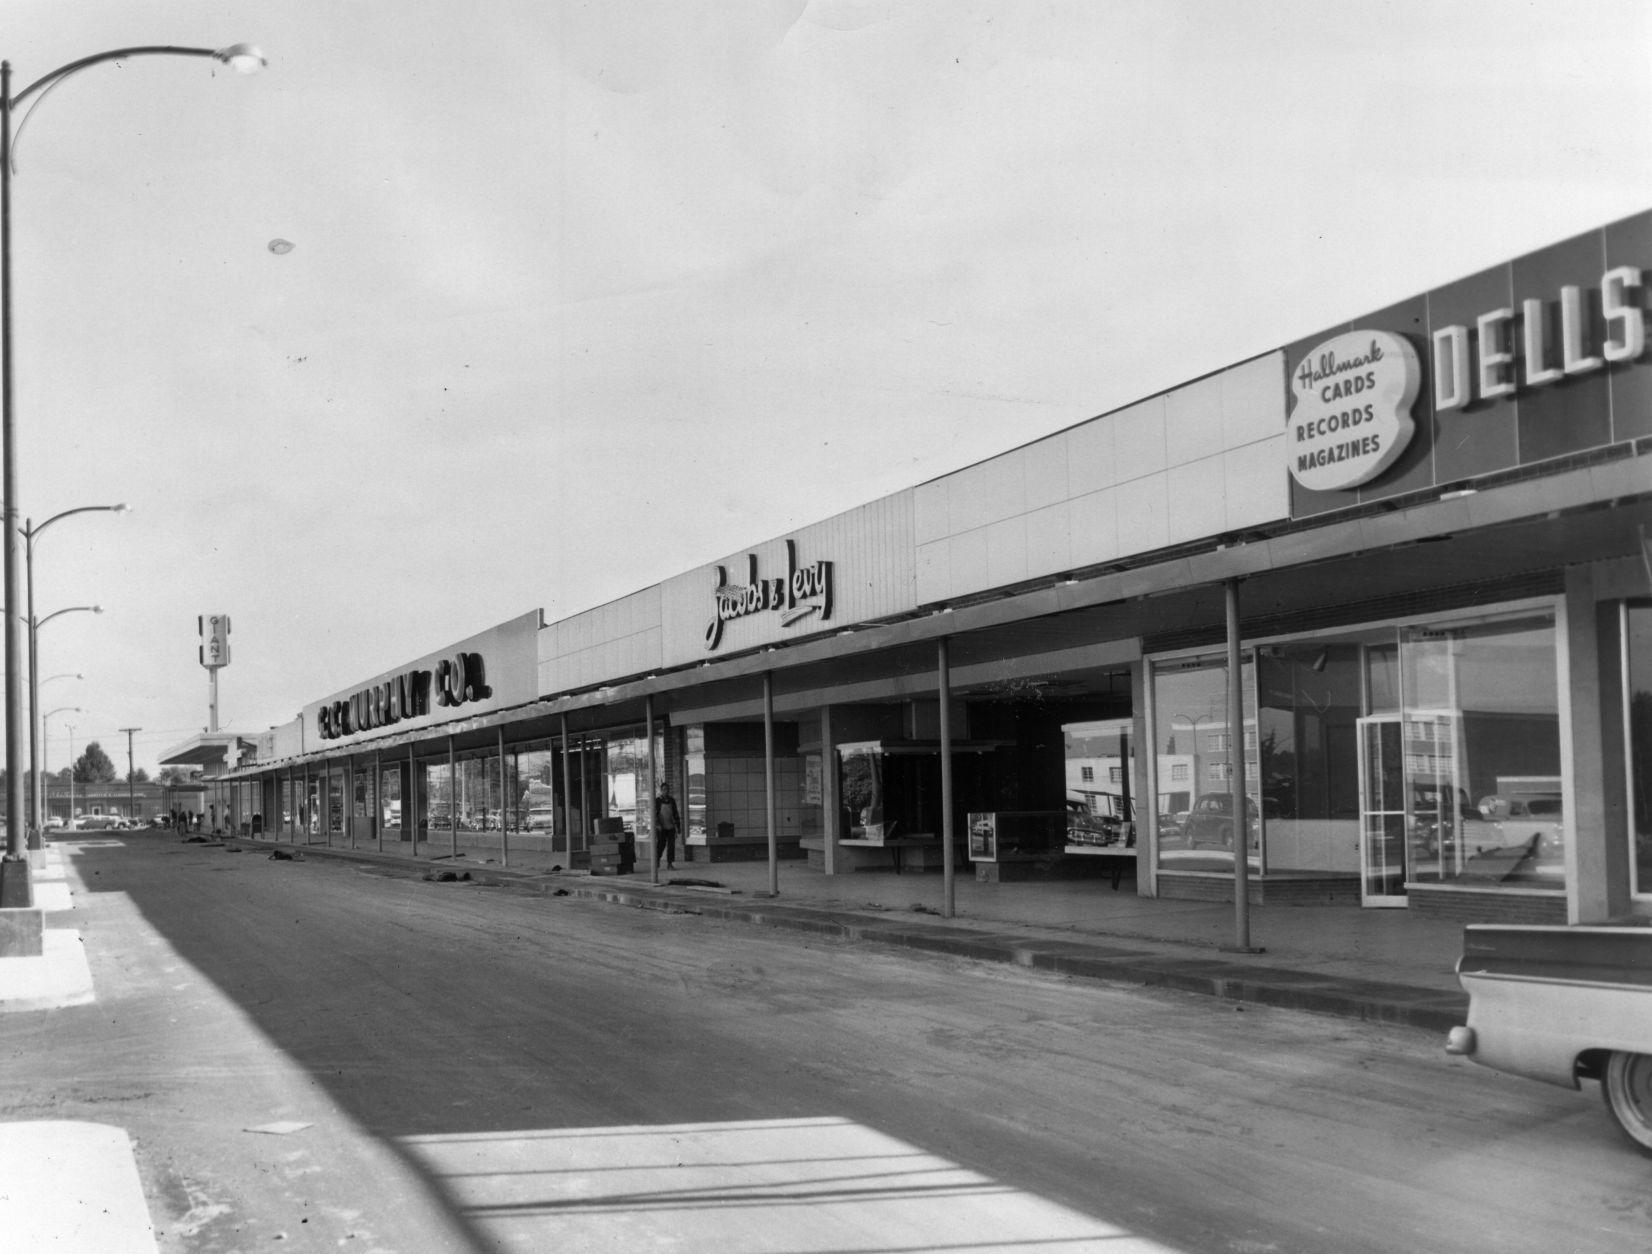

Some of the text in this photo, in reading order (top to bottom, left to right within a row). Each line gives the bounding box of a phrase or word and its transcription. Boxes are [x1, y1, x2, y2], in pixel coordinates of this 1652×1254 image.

[1432, 265, 1646, 412] DELLS
[1298, 339, 1384, 389] Hallmark
[1321, 371, 1375, 403] CARDS
[1296, 404, 1374, 442] RECORDS
[1297, 434, 1380, 472] MAGAZINES
[210, 616, 220, 663] GIANT
[342, 670, 431, 736] MURPHY
